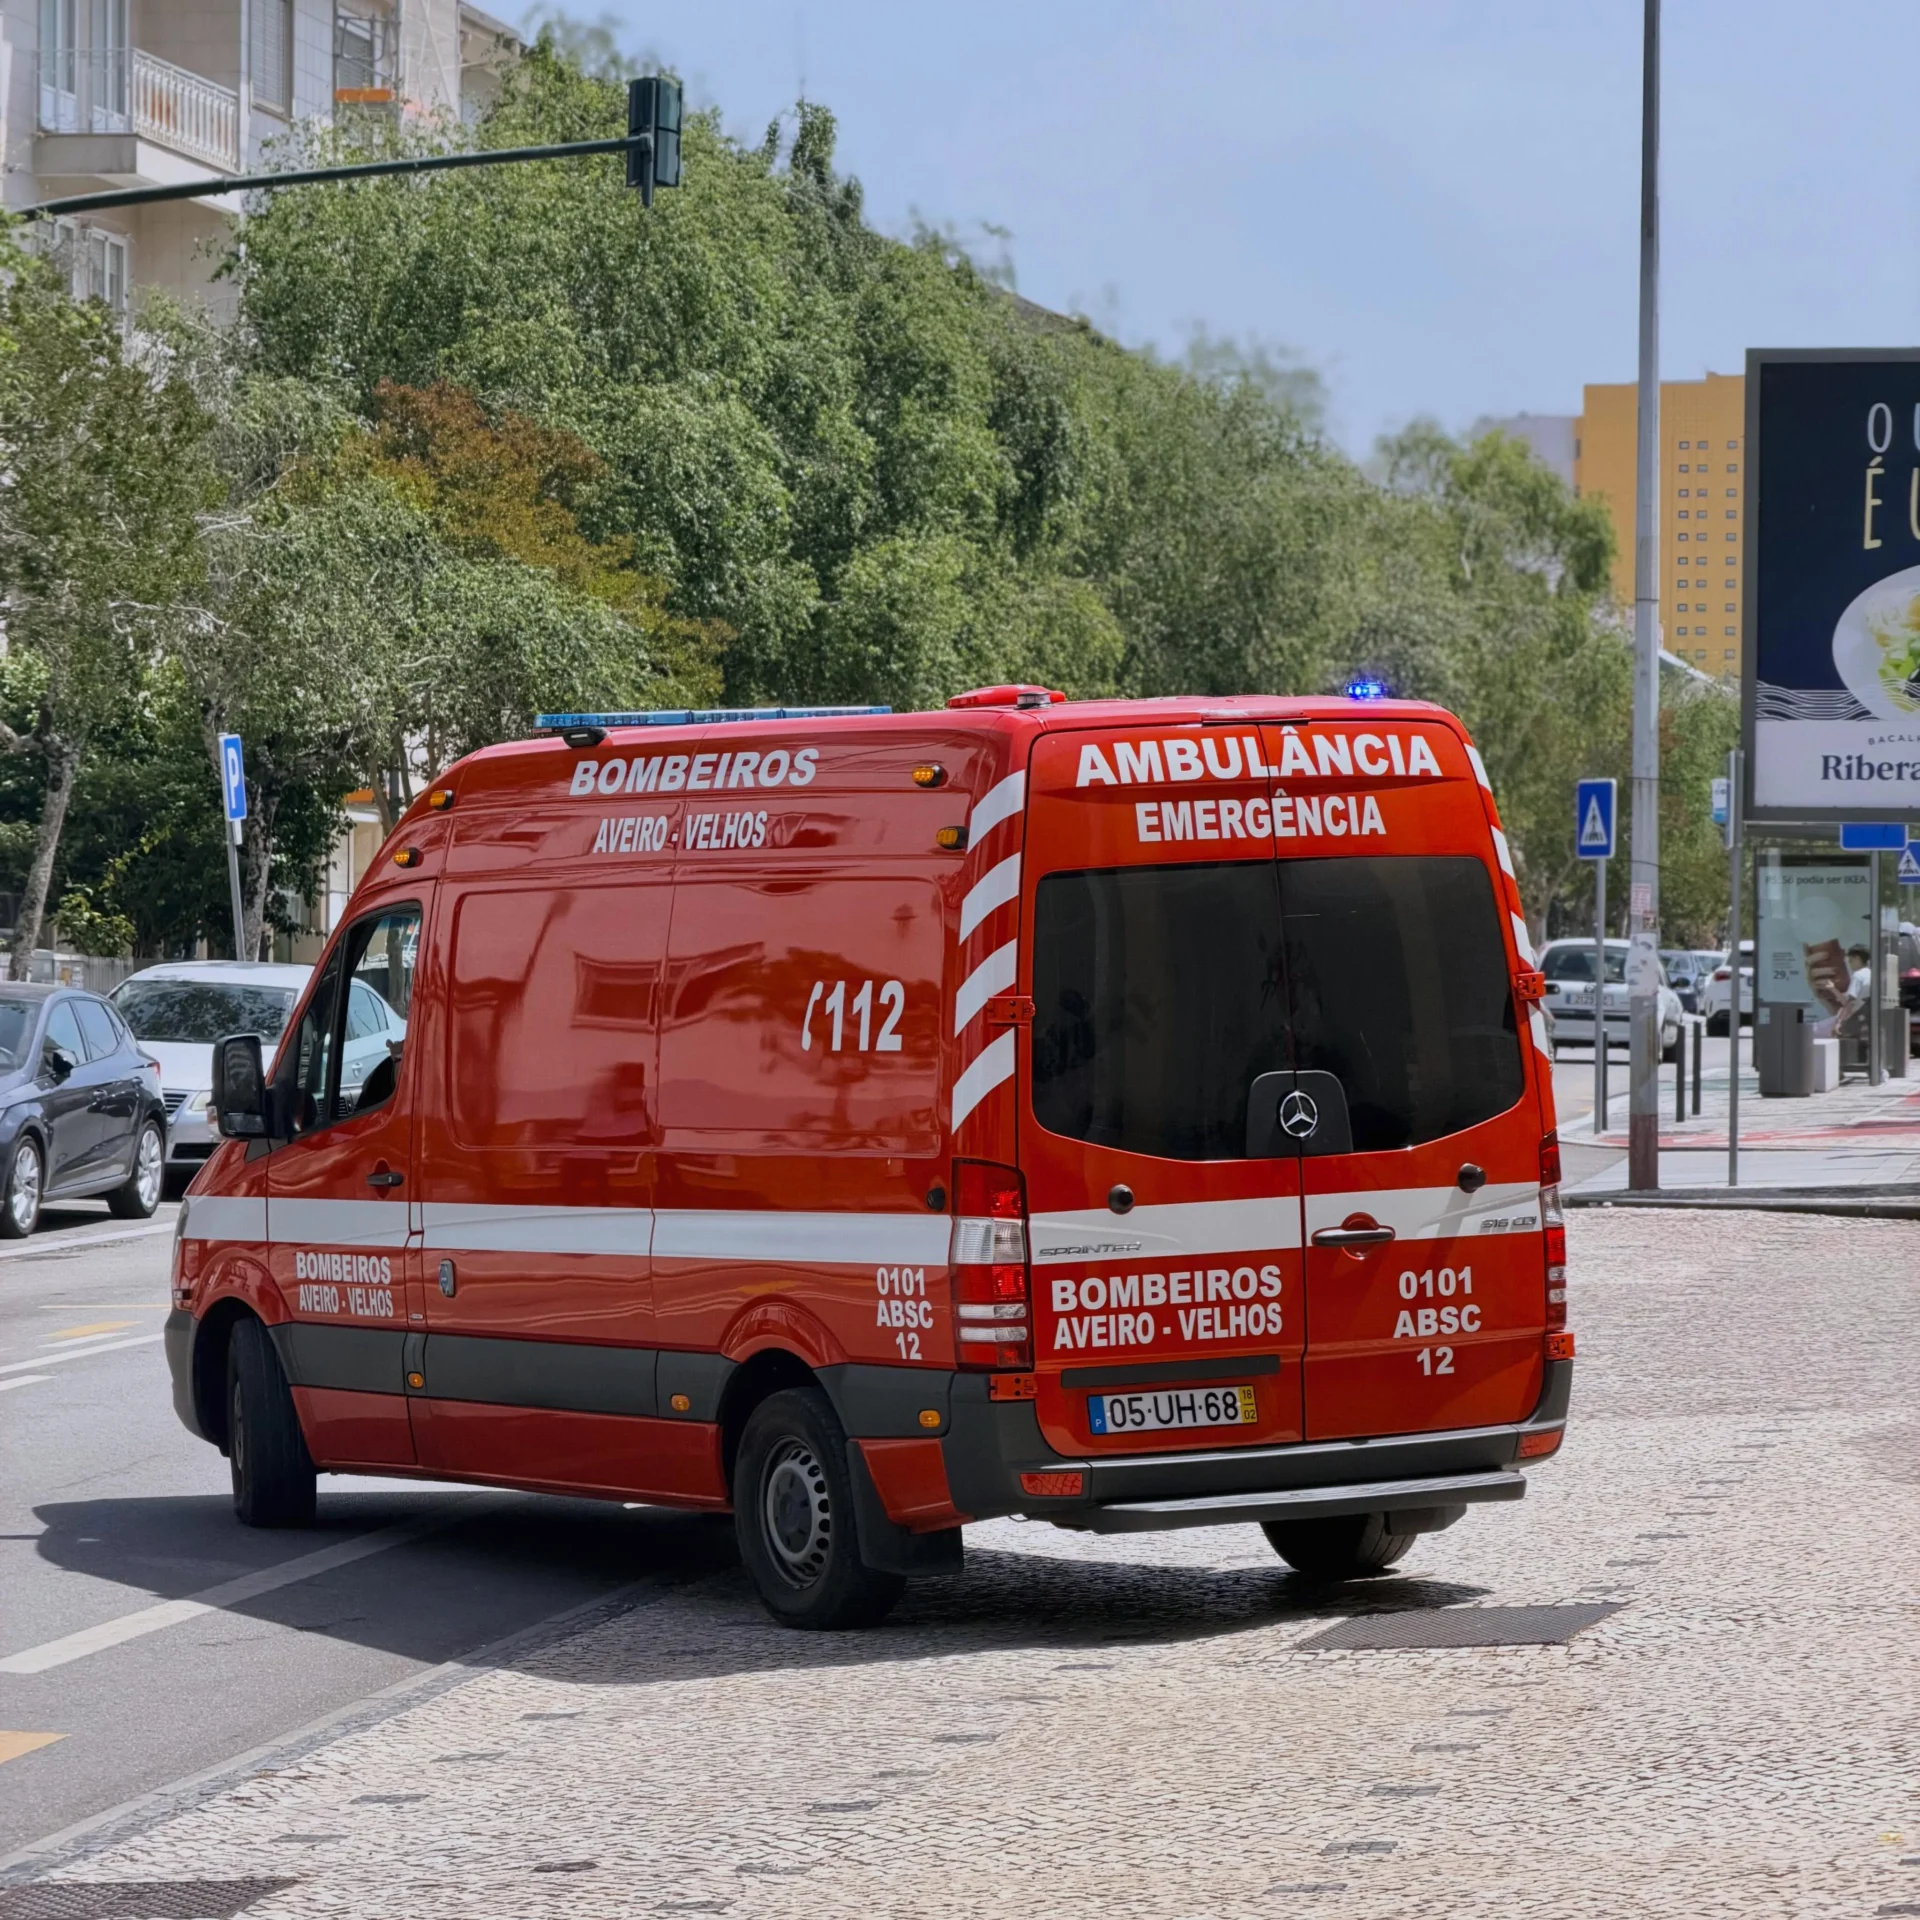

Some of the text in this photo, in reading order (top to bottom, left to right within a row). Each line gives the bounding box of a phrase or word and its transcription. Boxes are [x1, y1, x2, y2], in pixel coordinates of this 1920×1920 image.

[569, 748, 820, 796] BOMBEIROS
[1075, 725, 1443, 788] AMBULÂNCIA
[227, 747, 240, 809] P
[592, 815, 668, 853] AVEIRO
[685, 810, 768, 850] VELHOS
[1135, 788, 1387, 843] EMERGÊNCIA
[1826, 876, 1842, 885] ser
[825, 980, 905, 1051] 112
[1039, 1243, 1142, 1257] SPRINTER
[295, 1251, 392, 1285] BOMBEIROS
[876, 1266, 926, 1296] 0101
[1399, 1266, 1472, 1300] 0101
[299, 1284, 340, 1314] AVEIRO
[347, 1287, 394, 1318] VELHOS
[1051, 1265, 1282, 1312] BOMBEIROS
[876, 1299, 934, 1329] ABSC
[1053, 1312, 1155, 1350] AVEIRO
[1178, 1302, 1282, 1341] VELHOS
[1393, 1304, 1482, 1339] ABSC
[895, 1331, 922, 1360] 12
[1416, 1346, 1455, 1376] 12
[1095, 1418, 1102, 1427] P
[1244, 1409, 1256, 1420] 02
